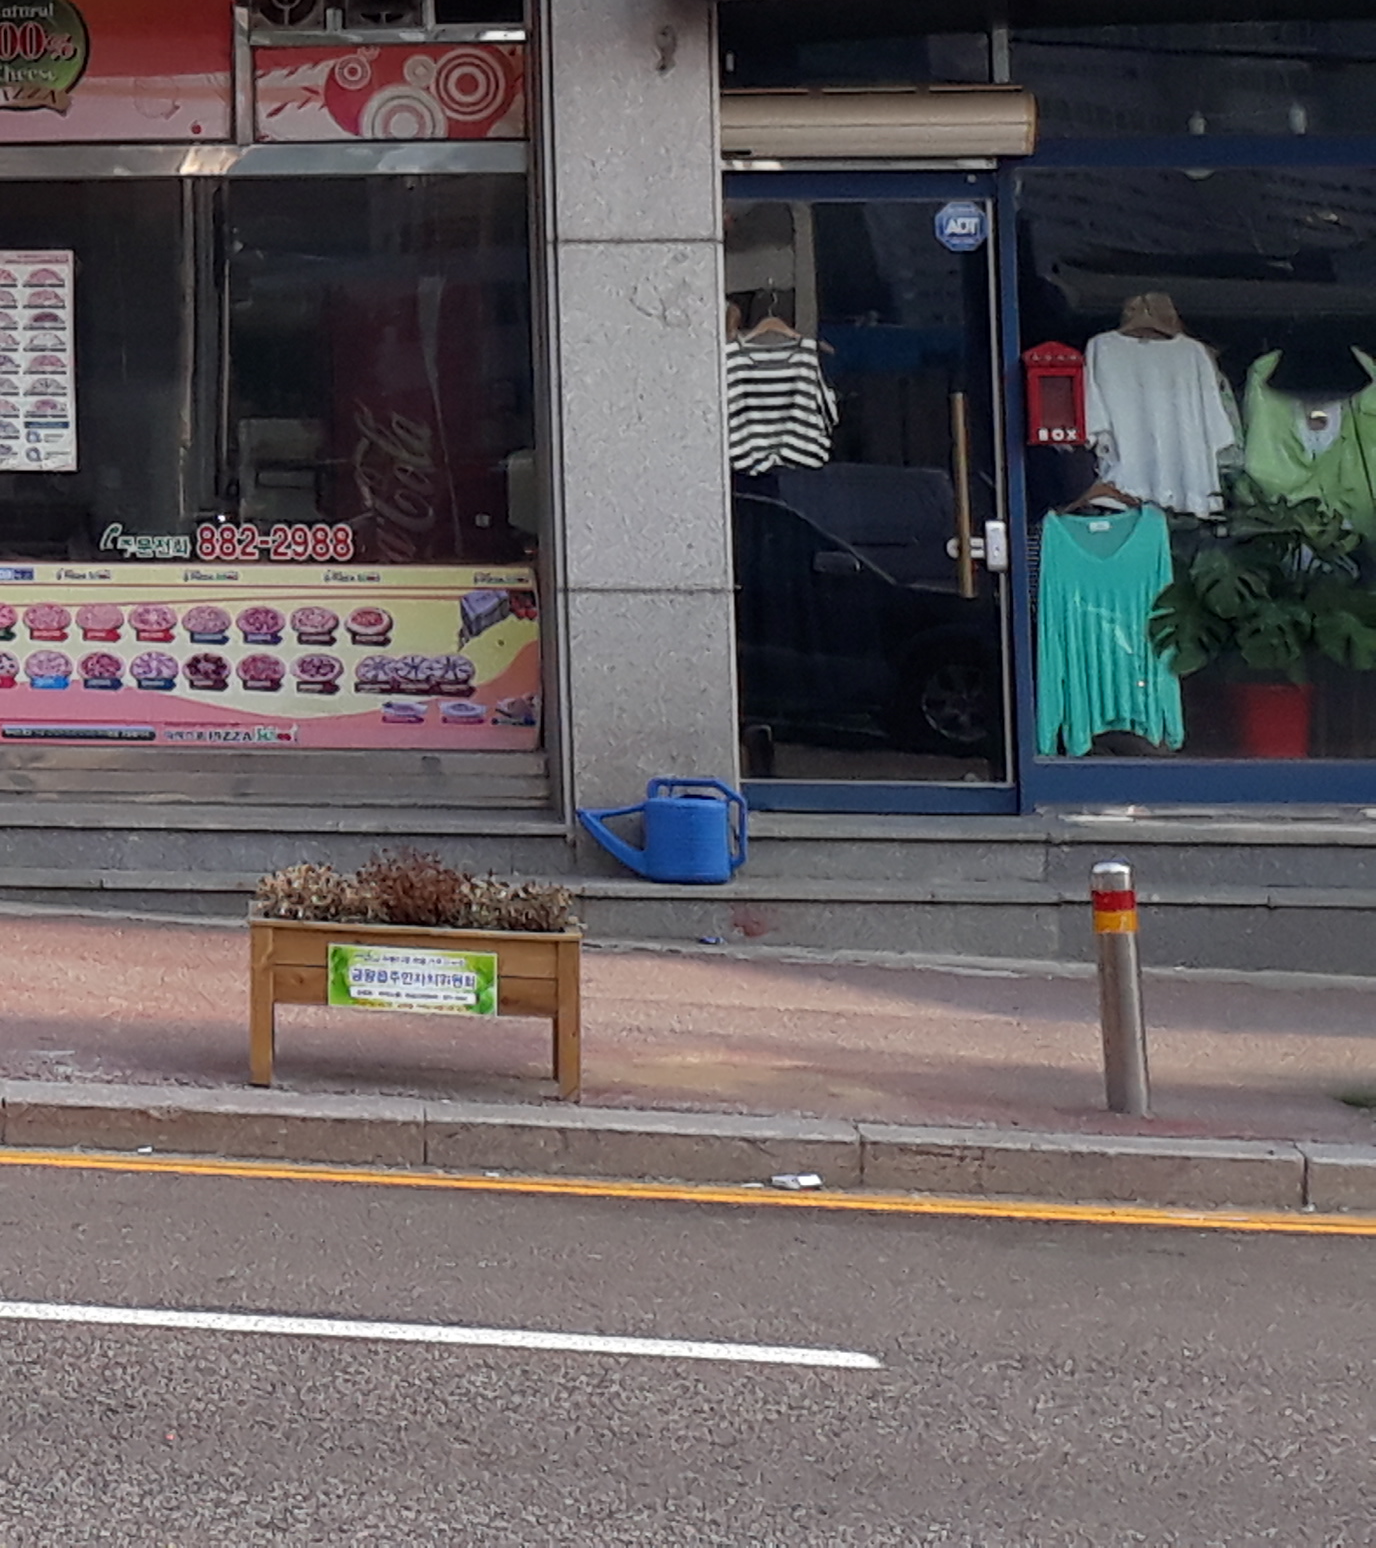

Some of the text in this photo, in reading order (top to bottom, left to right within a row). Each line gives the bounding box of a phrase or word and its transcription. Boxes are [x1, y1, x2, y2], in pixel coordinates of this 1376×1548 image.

[944, 216, 981, 234] ADT
[1037, 427, 1078, 442] BOX
[195, 522, 355, 560] 882-2988
